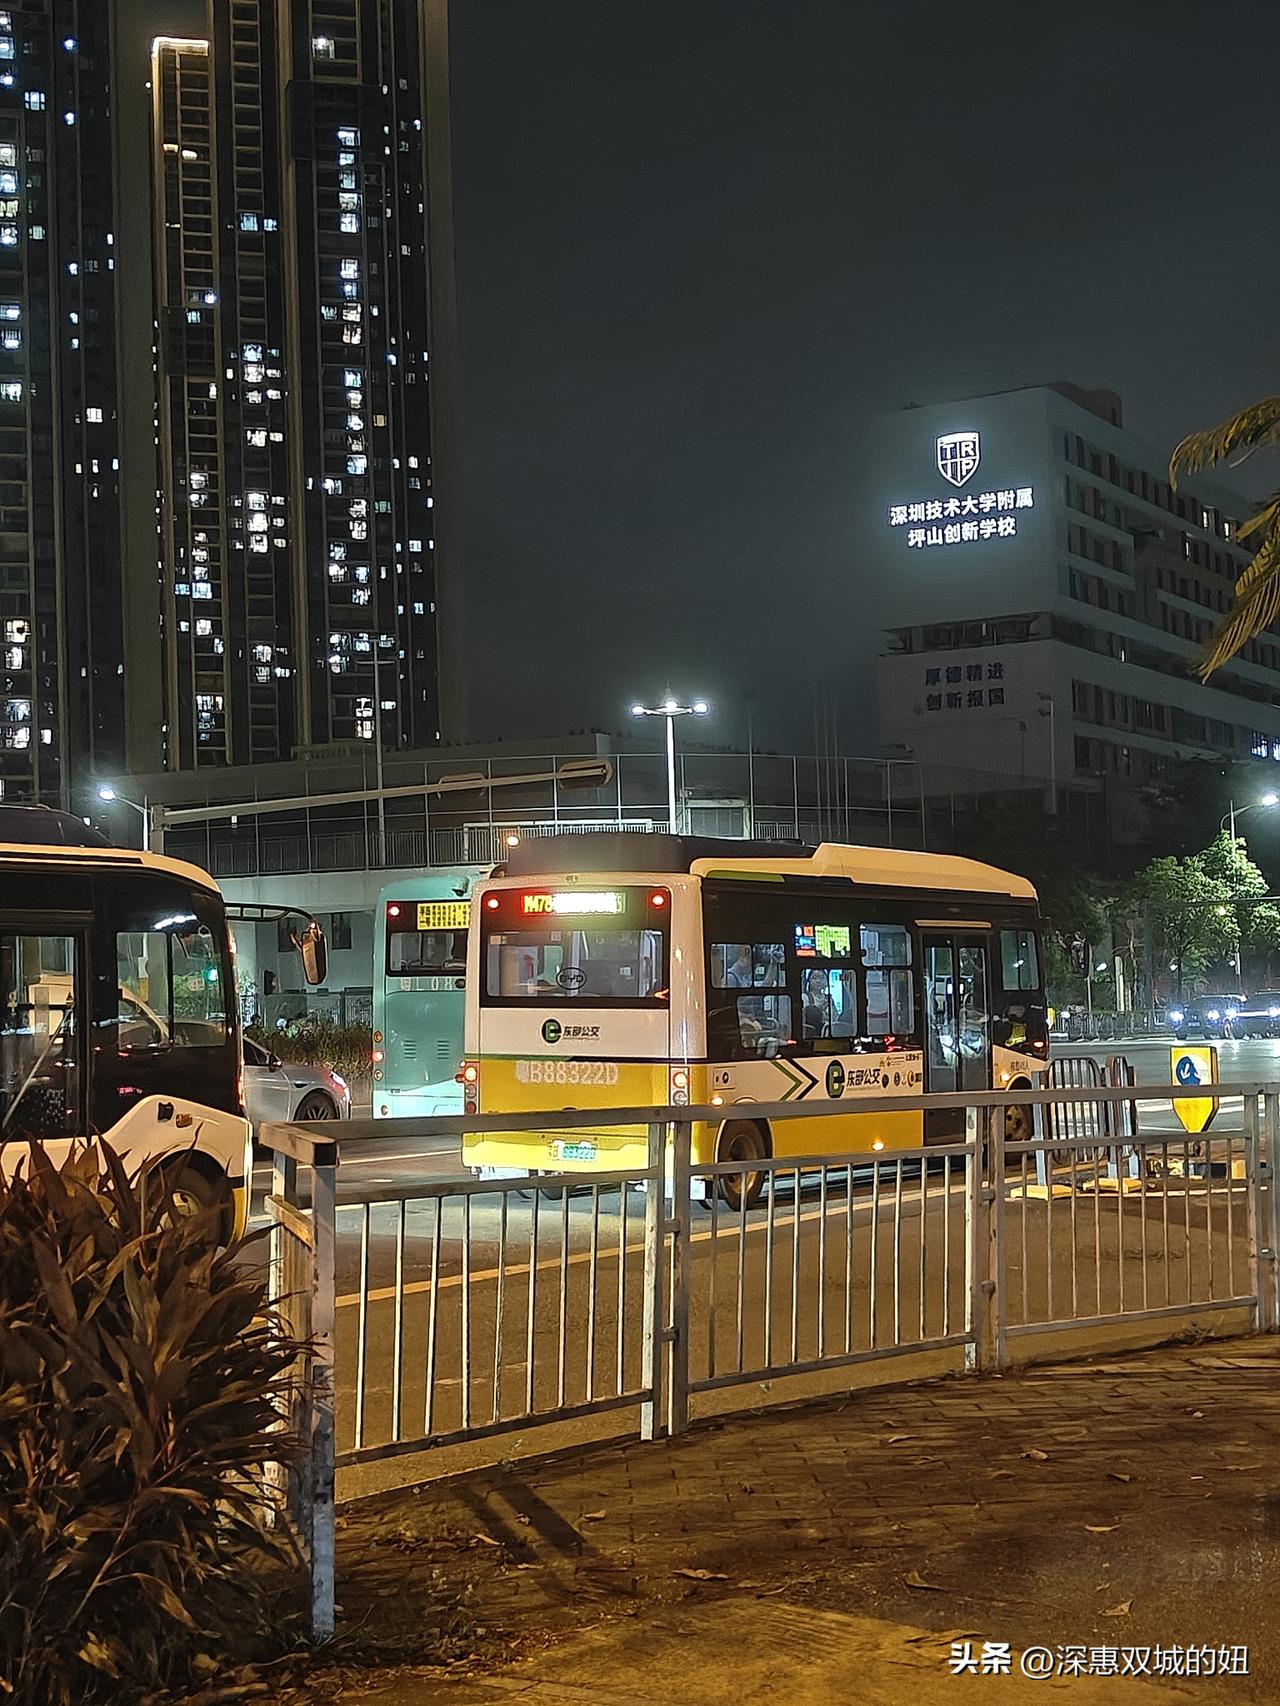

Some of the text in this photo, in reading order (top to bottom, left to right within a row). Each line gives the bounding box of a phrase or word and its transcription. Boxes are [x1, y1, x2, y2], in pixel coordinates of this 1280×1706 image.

[890, 487, 1033, 526] 深圳技术大学附属
[907, 516, 1016, 548] 坪山创新学校
[563, 1026, 600, 1037] 东部公交
[847, 1068, 880, 1087] 东部公交
